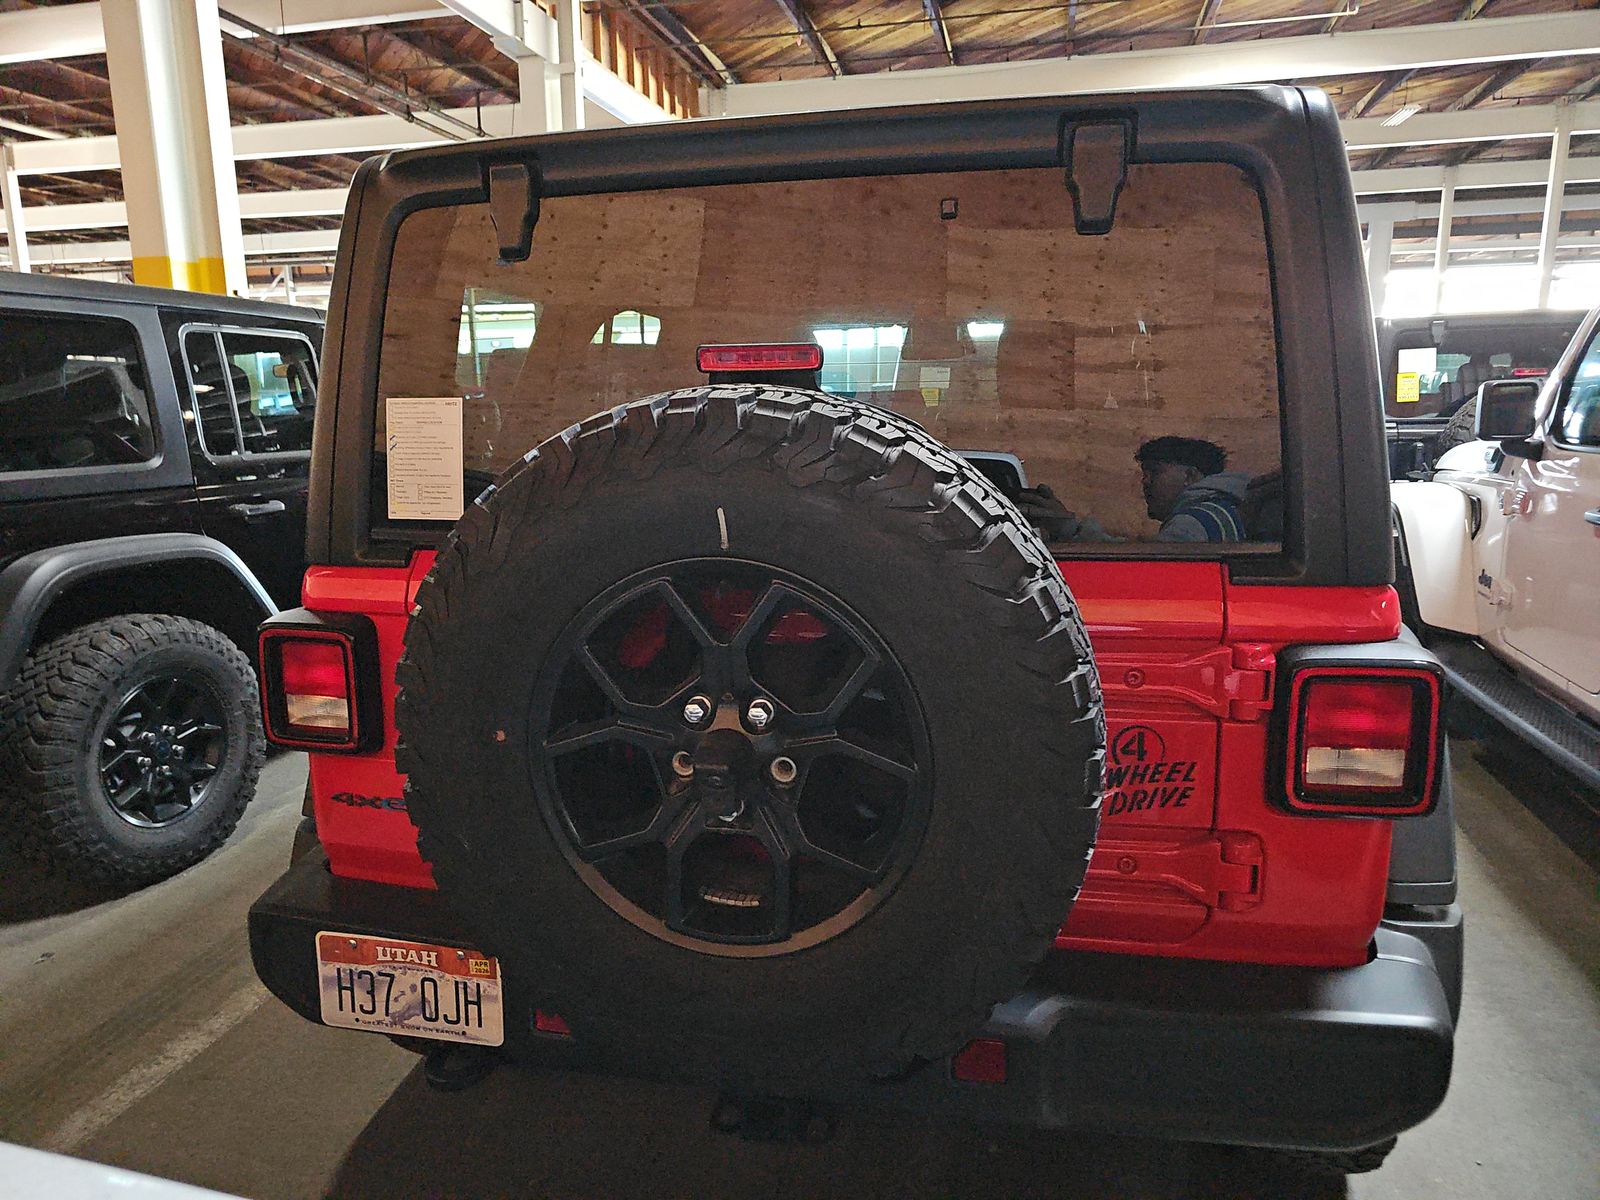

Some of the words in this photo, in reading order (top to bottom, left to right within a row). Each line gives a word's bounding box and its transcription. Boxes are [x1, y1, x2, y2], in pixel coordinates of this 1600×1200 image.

[1120, 731, 1147, 762] 4
[1106, 761, 1197, 790] WHEEL
[1108, 786, 1195, 817] DRIVE
[375, 946, 438, 967] UTAH
[336, 967, 396, 1017] H37
